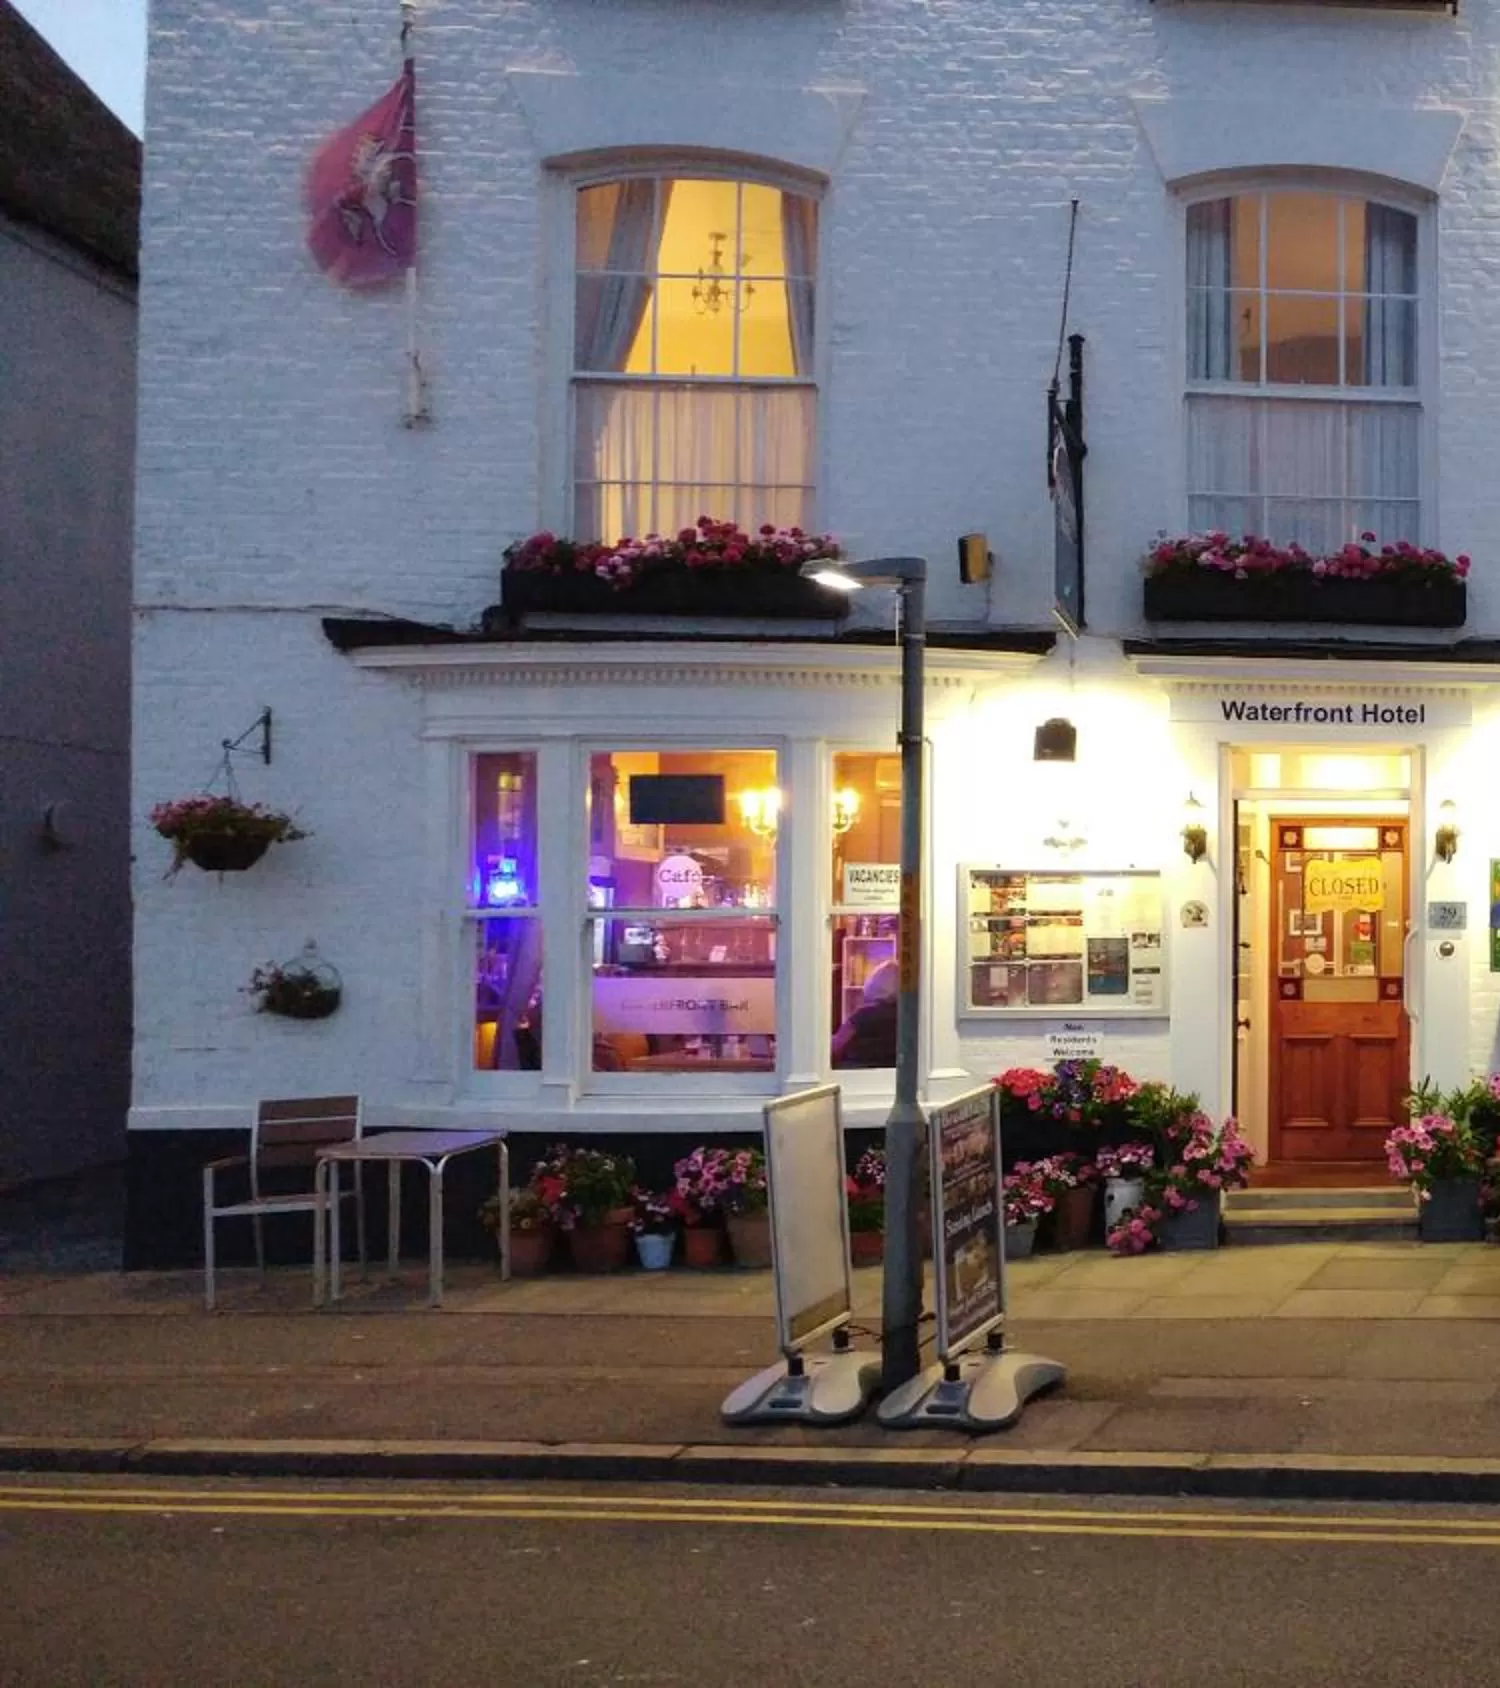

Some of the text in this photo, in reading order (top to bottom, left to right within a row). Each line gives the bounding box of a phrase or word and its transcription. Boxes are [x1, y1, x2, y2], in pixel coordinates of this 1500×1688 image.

[1221, 701, 1425, 724] Waterfront Hotel
[1309, 877, 1379, 897] CLOSED
